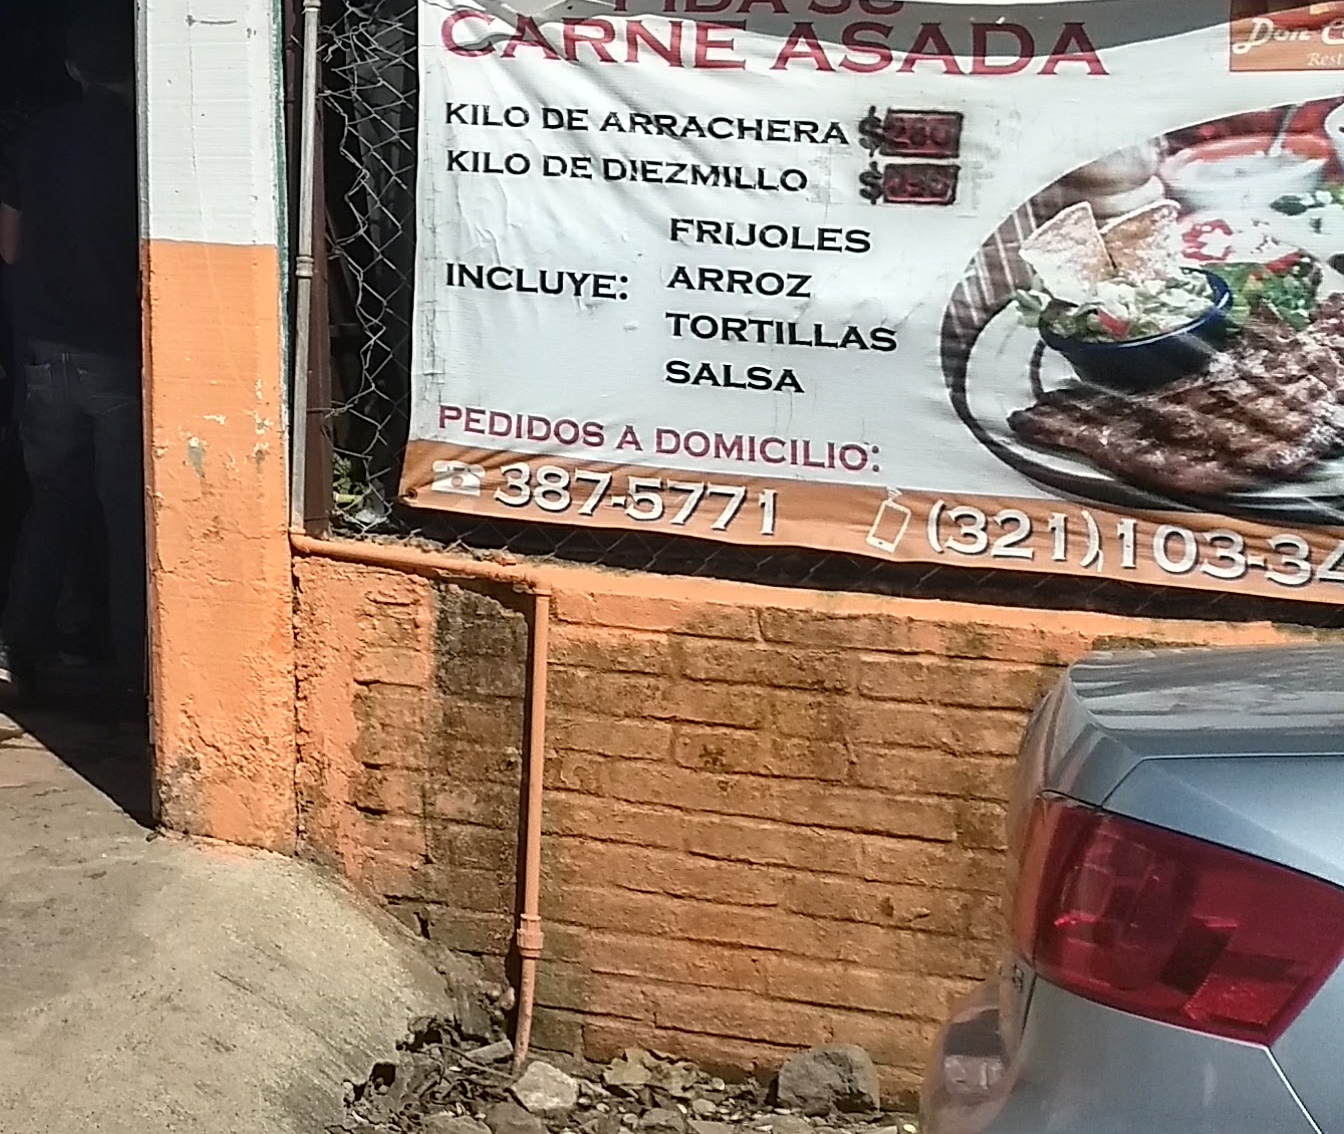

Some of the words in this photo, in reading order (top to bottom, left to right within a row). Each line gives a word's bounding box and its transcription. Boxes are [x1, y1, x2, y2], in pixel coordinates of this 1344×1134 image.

[440, 9, 748, 71] CARNE
[769, 21, 1110, 76] ASADA
[1232, 17, 1311, 55] Don
[445, 102, 530, 129] KILO
[542, 107, 589, 132] DE
[599, 111, 850, 146] ARRACHERA
[446, 149, 531, 176] KILO
[542, 154, 592, 180] DE
[602, 157, 808, 192] DIEZMILLO
[668, 217, 872, 254] FRIJOLES
[445, 262, 630, 301] INCLUYE:
[665, 266, 812, 299] ARROZ
[665, 311, 898, 352] TORTILLAS
[665, 360, 805, 394] SALSA
[438, 404, 606, 448] PEDIDOS
[615, 424, 644, 452] A
[655, 427, 881, 473] DOMICILIO:
[493, 462, 779, 535] 387-5771
